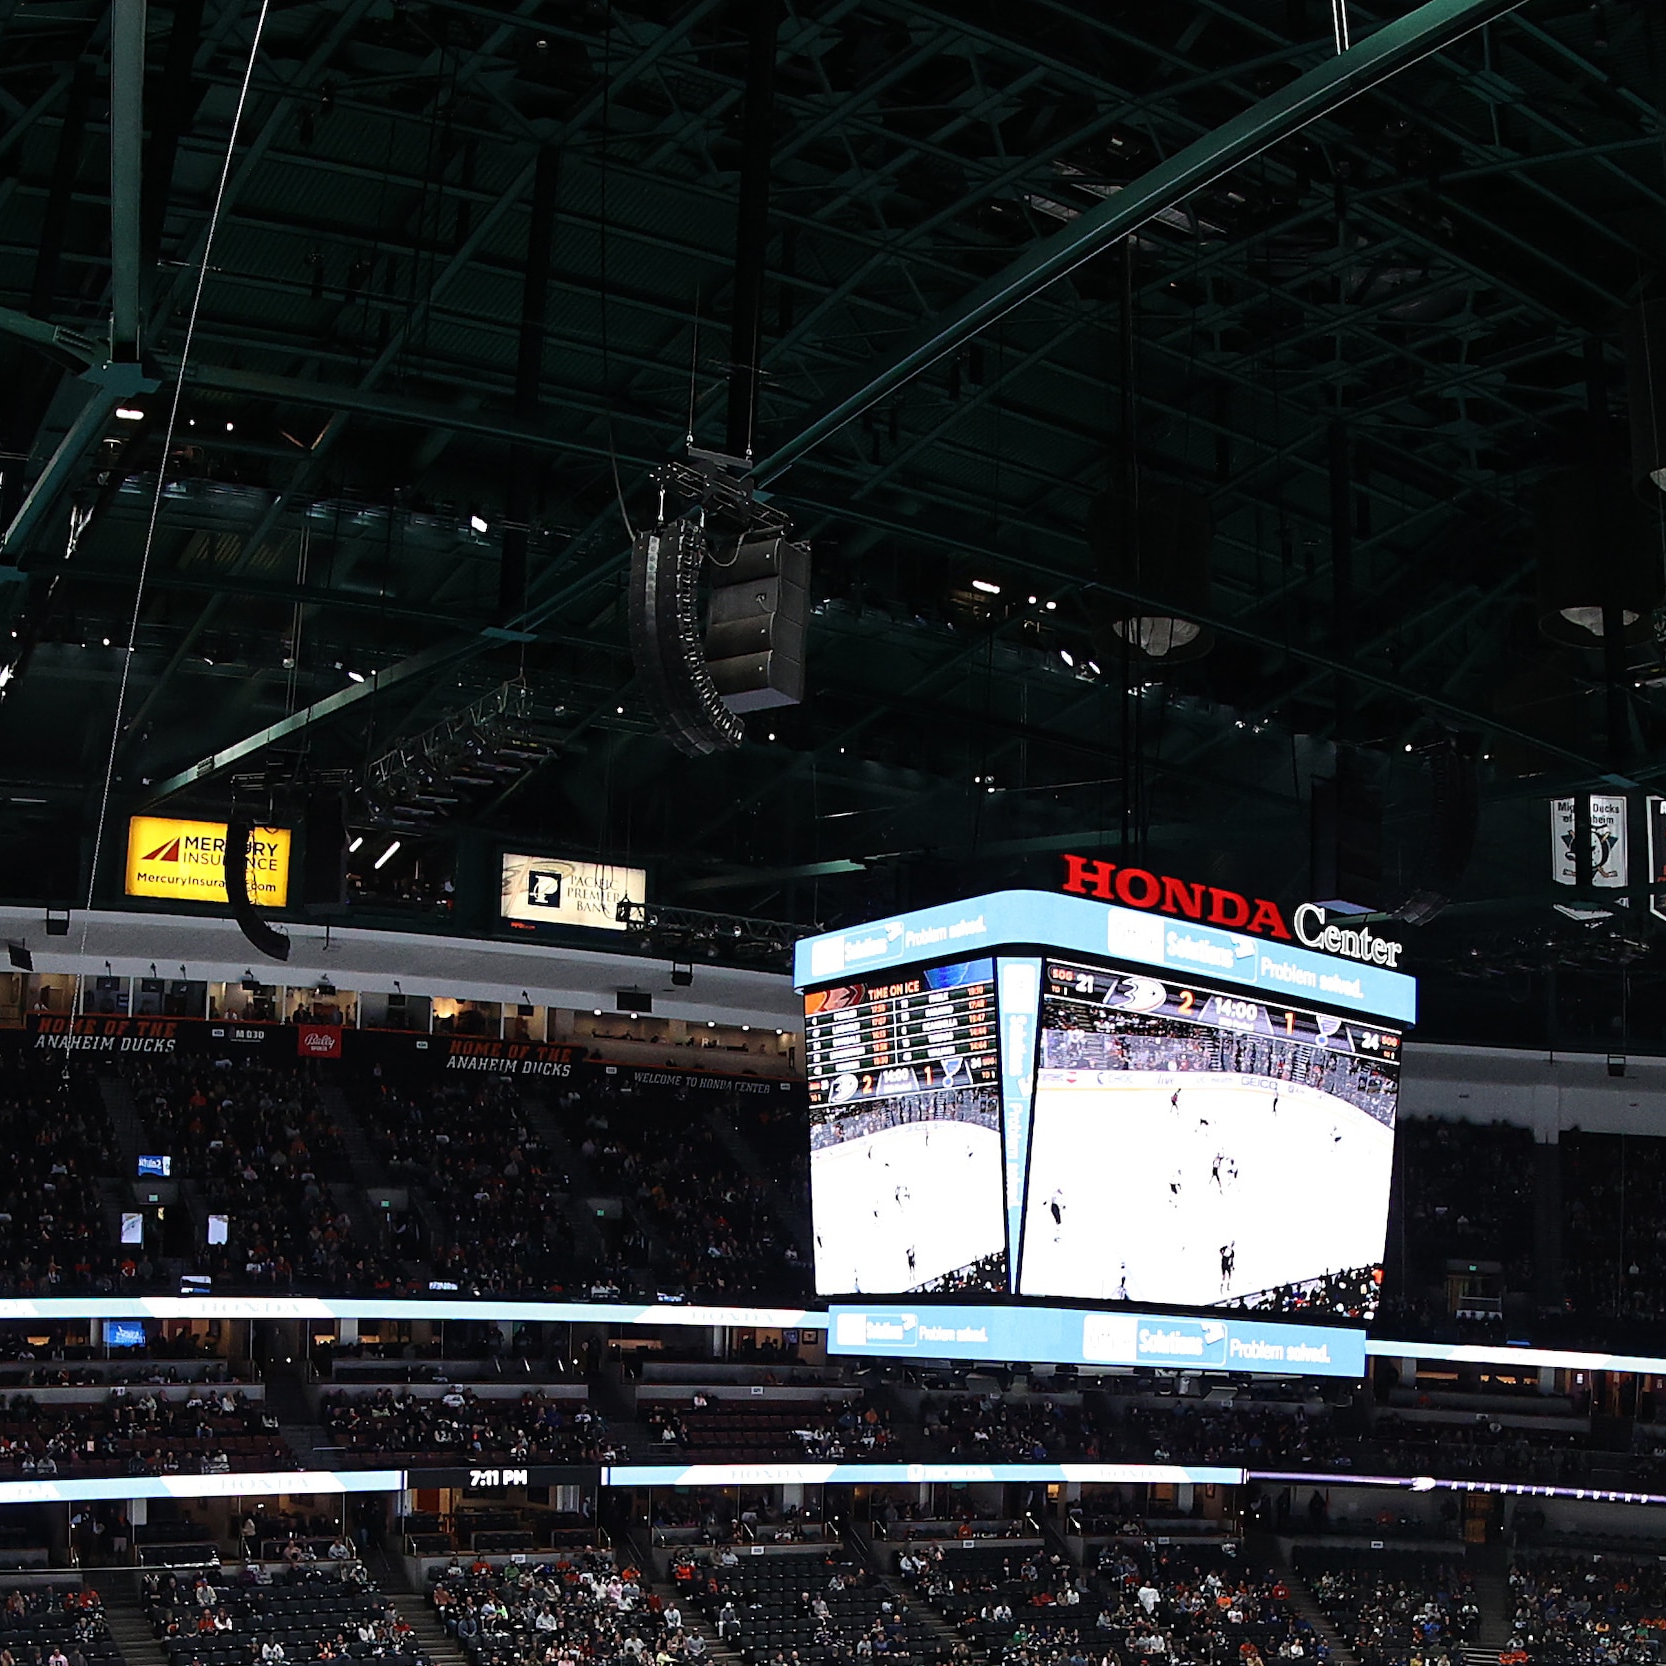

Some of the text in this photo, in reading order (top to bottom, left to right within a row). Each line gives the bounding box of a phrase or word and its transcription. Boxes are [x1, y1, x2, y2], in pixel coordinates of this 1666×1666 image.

[1593, 802, 1619, 814] Ducks
[567, 887, 621, 902] PREMIER
[576, 901, 612, 913] BANK
[1061, 853, 1403, 967] HONDA Center
[1167, 931, 1364, 999] Solutions Problem solved.
[868, 980, 920, 1001] TIME ON ICE
[1075, 975, 1094, 994] 21
[1178, 991, 1194, 1015] 2
[1215, 997, 1257, 1020] 14:00
[1285, 1013, 1294, 1035] 1
[1362, 1032, 1379, 1050] 24
[37, 1017, 178, 1038] HOME OF THE
[34, 1034, 177, 1053] ANAHEIM DUCKS
[304, 1032, 335, 1047] Bally
[448, 1039, 572, 1062] HOME OF THE
[446, 1055, 572, 1078] ANAHEIM DUCKS
[634, 1071, 771, 1094] WELCOME TO HONDA CENTER
[862, 1075, 873, 1094] 2
[924, 1066, 932, 1085] 1
[1241, 1076, 1277, 1090] GEICO
[919, 1326, 955, 1342] Problem
[1139, 1329, 1330, 1364] Solutions Problem solved.
[470, 1470, 527, 1486] 7:11 PM
[1450, 1481, 1555, 1497] ANAHEIM
[1577, 1489, 1648, 1503] DUCKS
